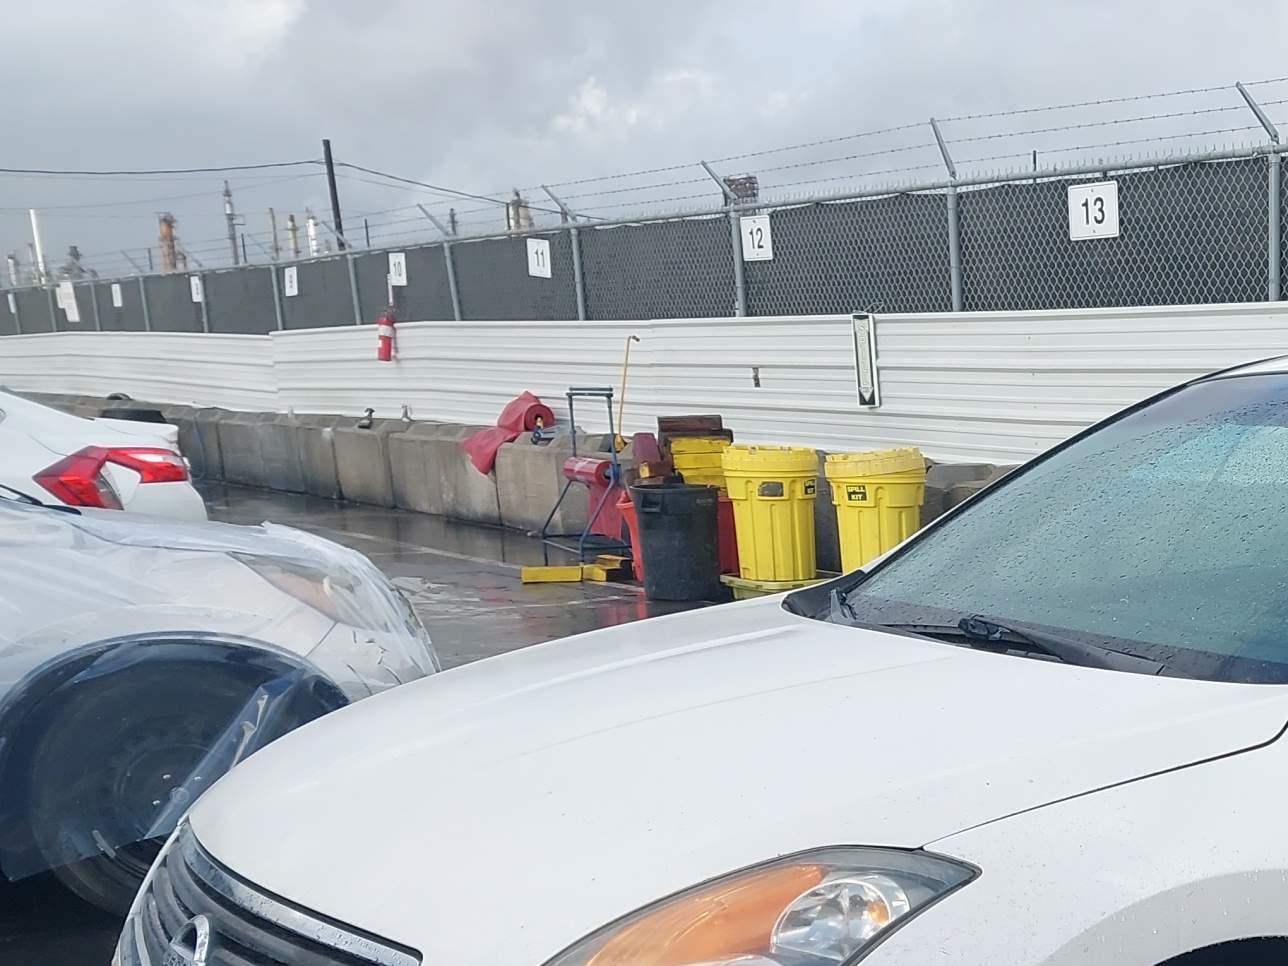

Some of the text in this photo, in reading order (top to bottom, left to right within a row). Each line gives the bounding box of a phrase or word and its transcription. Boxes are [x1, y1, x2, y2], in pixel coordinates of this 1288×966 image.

[1081, 196, 1105, 225] 13
[749, 227, 764, 249] 12
[534, 248, 545, 267] 11
[393, 261, 402, 277] 10
